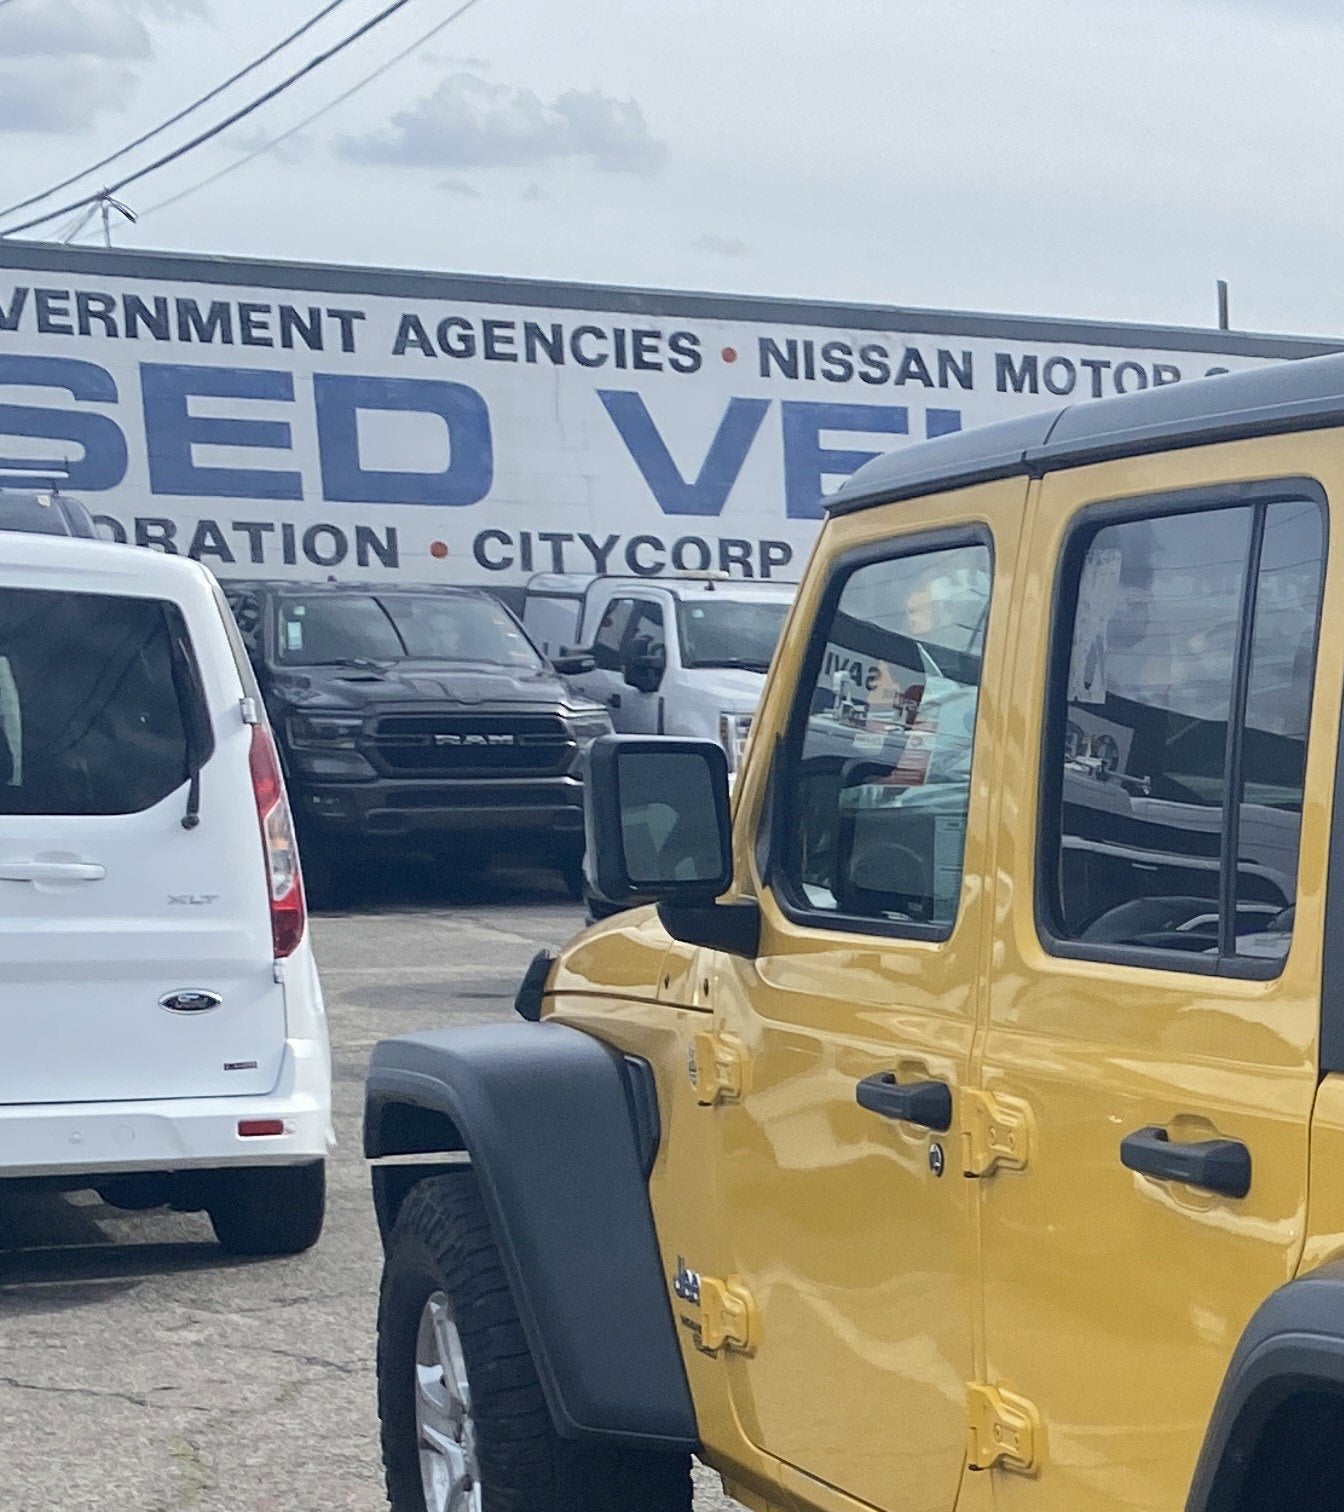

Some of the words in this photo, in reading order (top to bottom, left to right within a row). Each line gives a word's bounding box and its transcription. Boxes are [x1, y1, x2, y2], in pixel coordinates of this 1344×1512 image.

[392, 313, 702, 374] AGENCIES
[759, 338, 974, 391] NISSAN
[0, 354, 494, 507] SED
[596, 389, 962, 520] VE
[472, 528, 793, 578] CITYCORP
[434, 734, 515, 746] RAM
[168, 895, 219, 906] XLT
[674, 1255, 701, 1307] Jee
